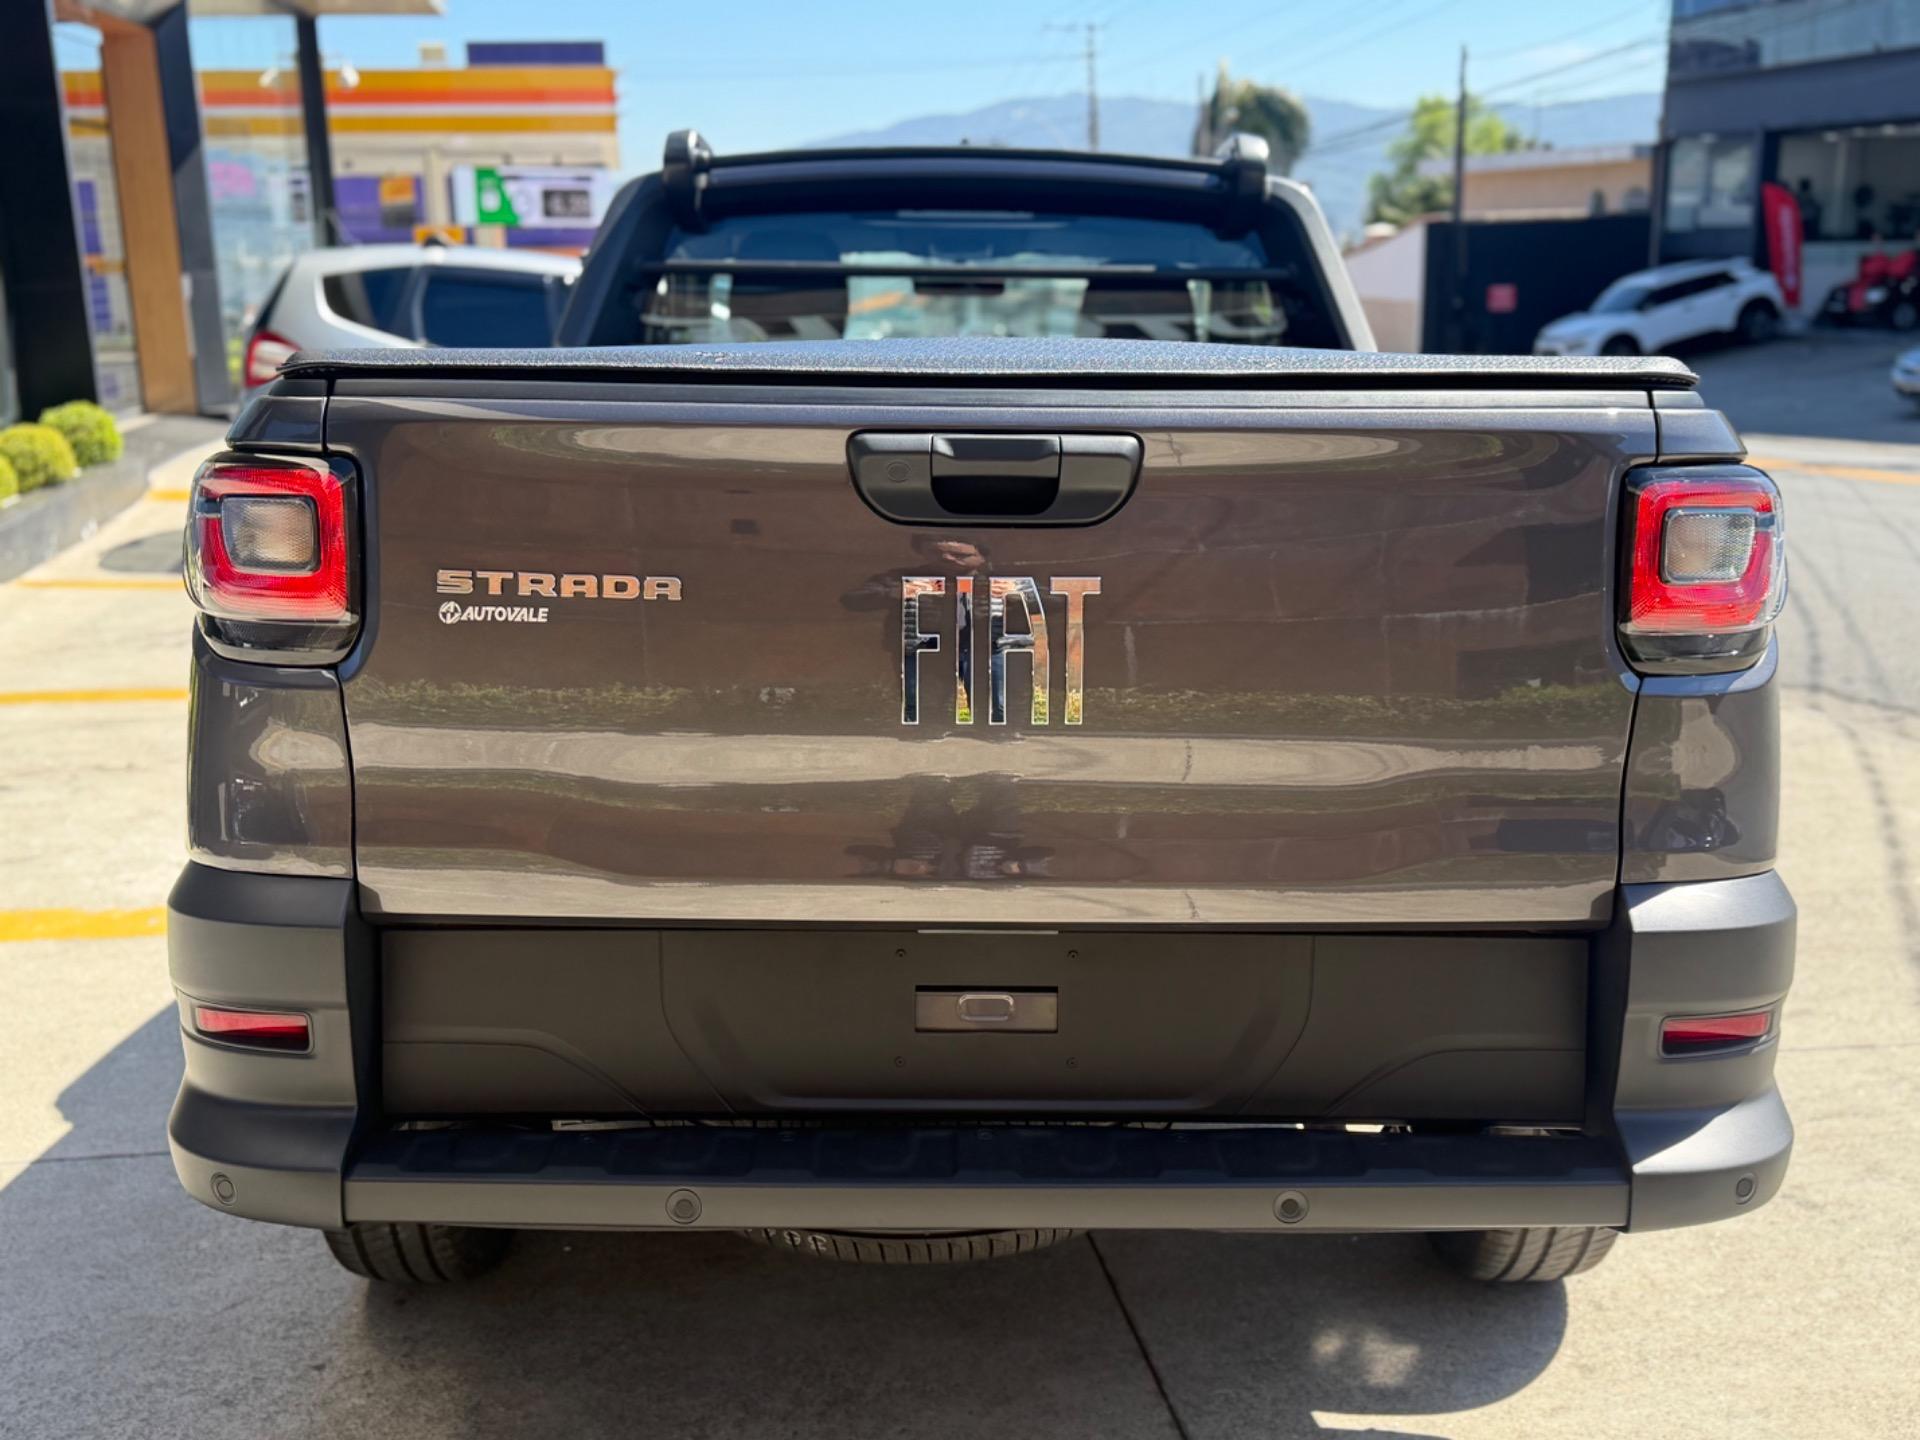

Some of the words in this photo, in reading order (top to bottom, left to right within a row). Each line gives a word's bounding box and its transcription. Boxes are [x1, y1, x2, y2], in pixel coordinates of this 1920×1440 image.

[436, 569, 682, 601] STRADA
[460, 605, 549, 623] AUTOVALE
[902, 576, 1101, 726] FIAT
